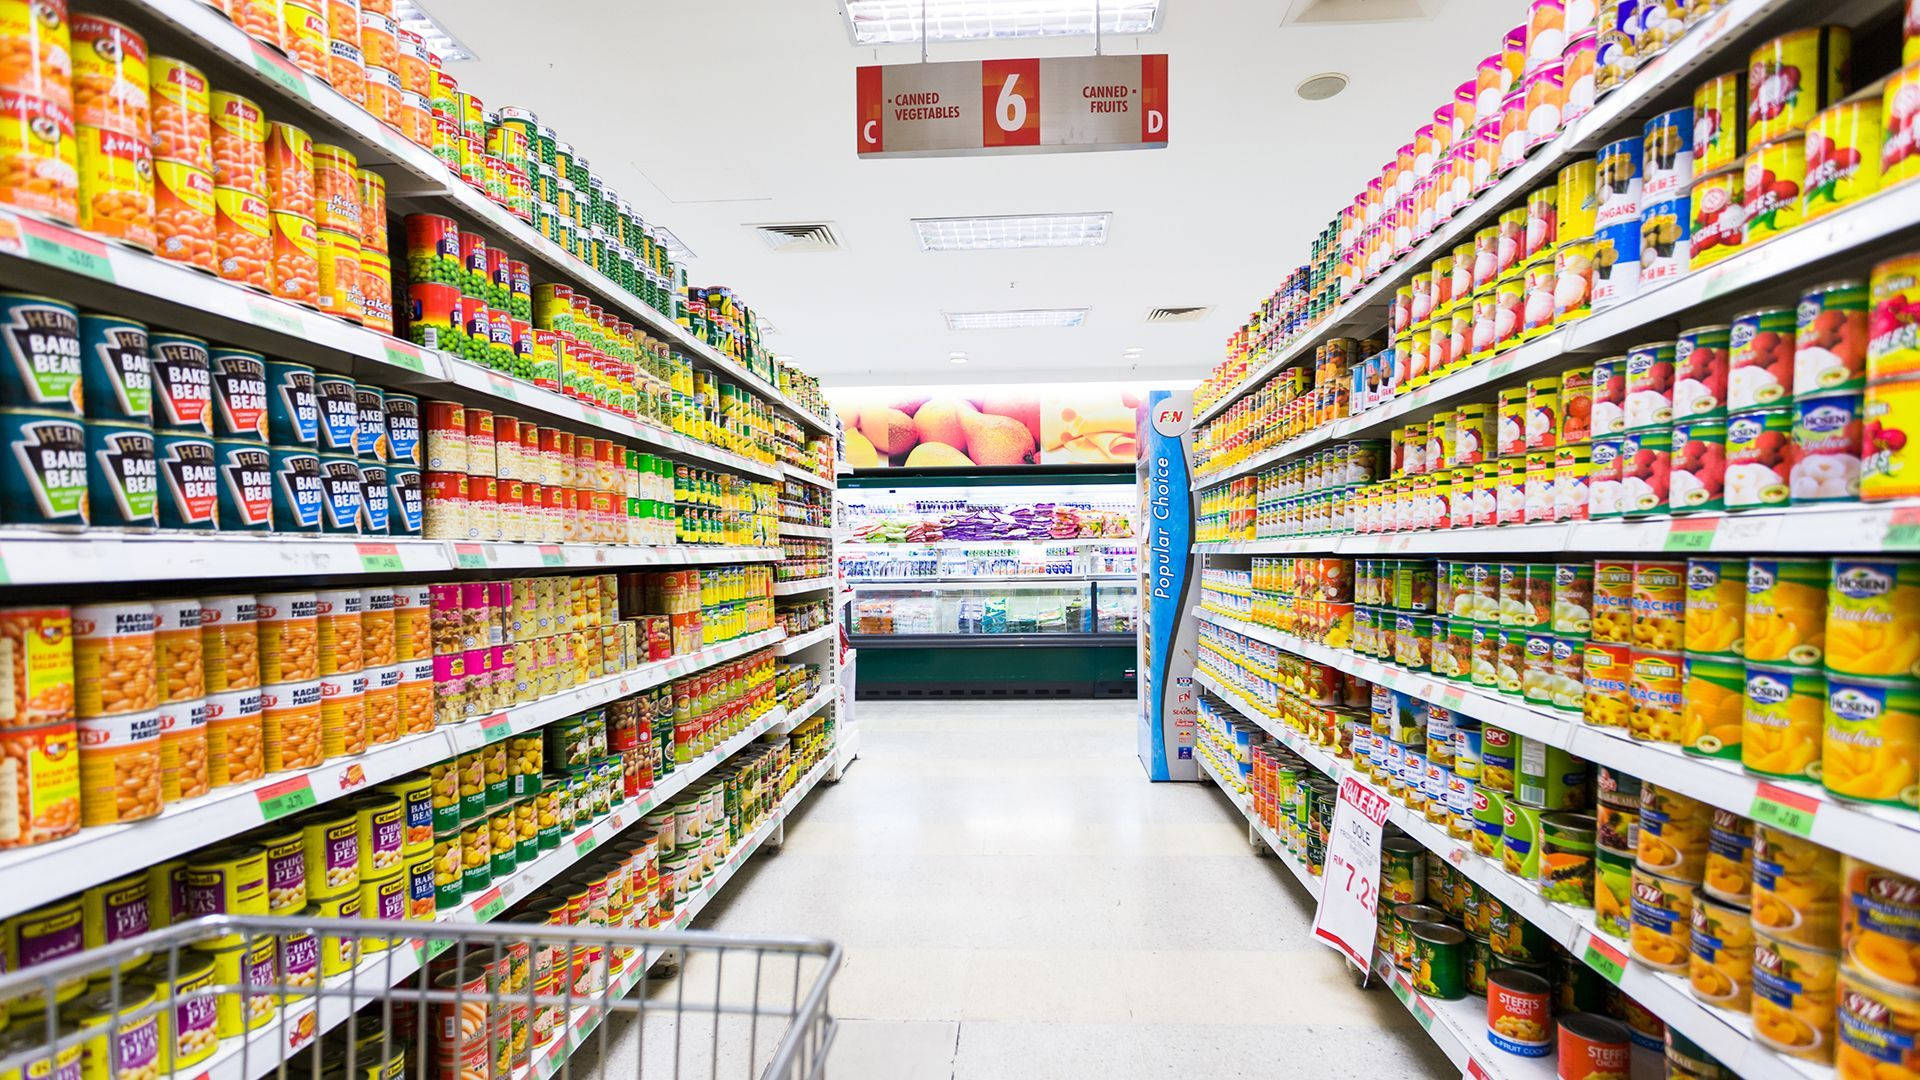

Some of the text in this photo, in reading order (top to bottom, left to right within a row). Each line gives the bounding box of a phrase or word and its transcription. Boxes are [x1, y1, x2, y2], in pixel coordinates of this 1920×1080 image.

[895, 92, 939, 106] CANNED
[1082, 85, 1128, 99] CANNED
[995, 73, 1027, 132] 6
[1090, 100, 1128, 113] FRUITS
[895, 106, 960, 121] VEGETABLES
[1147, 110, 1164, 134] D
[863, 120, 877, 144] C
[1153, 456, 1171, 599] Popular Choice
[1838, 575, 1887, 591] HOSEN
[1485, 730, 1508, 743] SPC
[1351, 819, 1371, 847] DOLE
